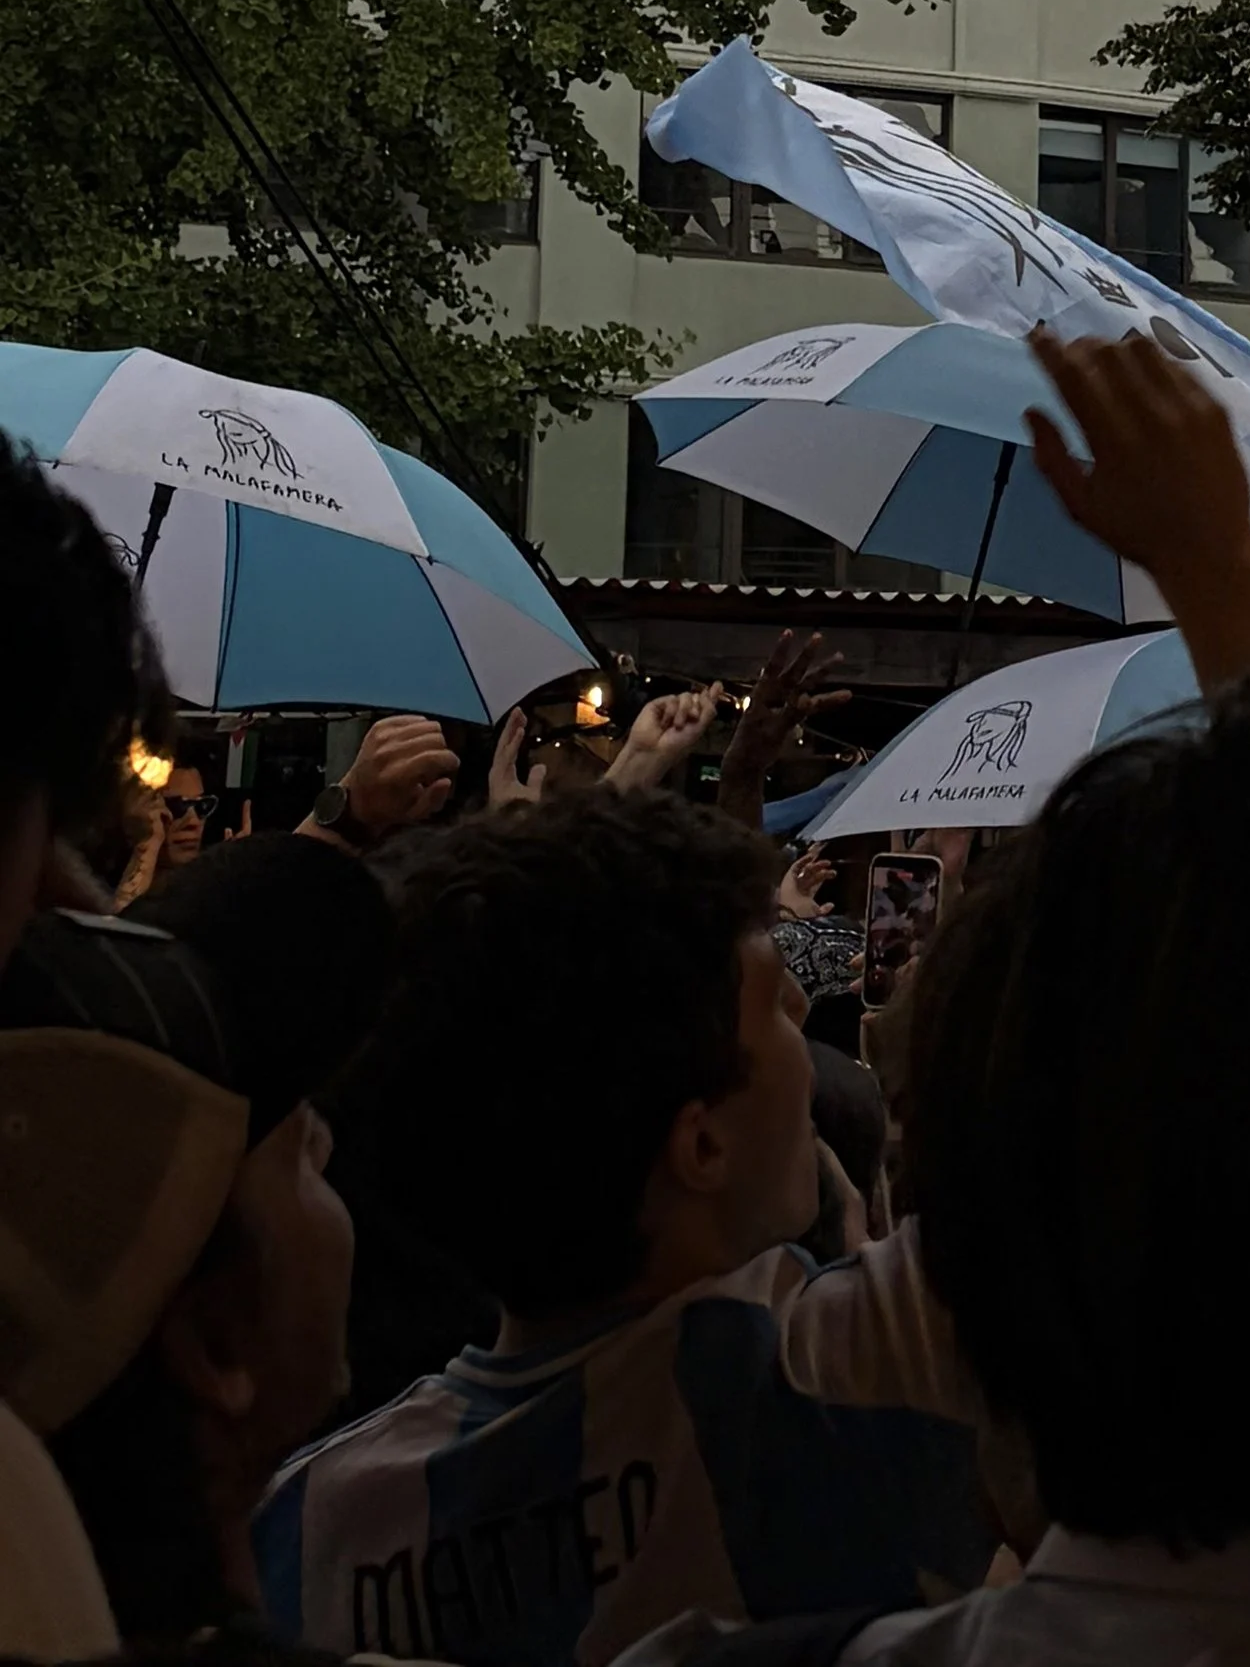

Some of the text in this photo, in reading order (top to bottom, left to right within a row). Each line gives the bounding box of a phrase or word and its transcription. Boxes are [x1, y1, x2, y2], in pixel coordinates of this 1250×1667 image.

[161, 452, 343, 512] LA MALAFAMERA
[899, 788, 920, 803] LA
